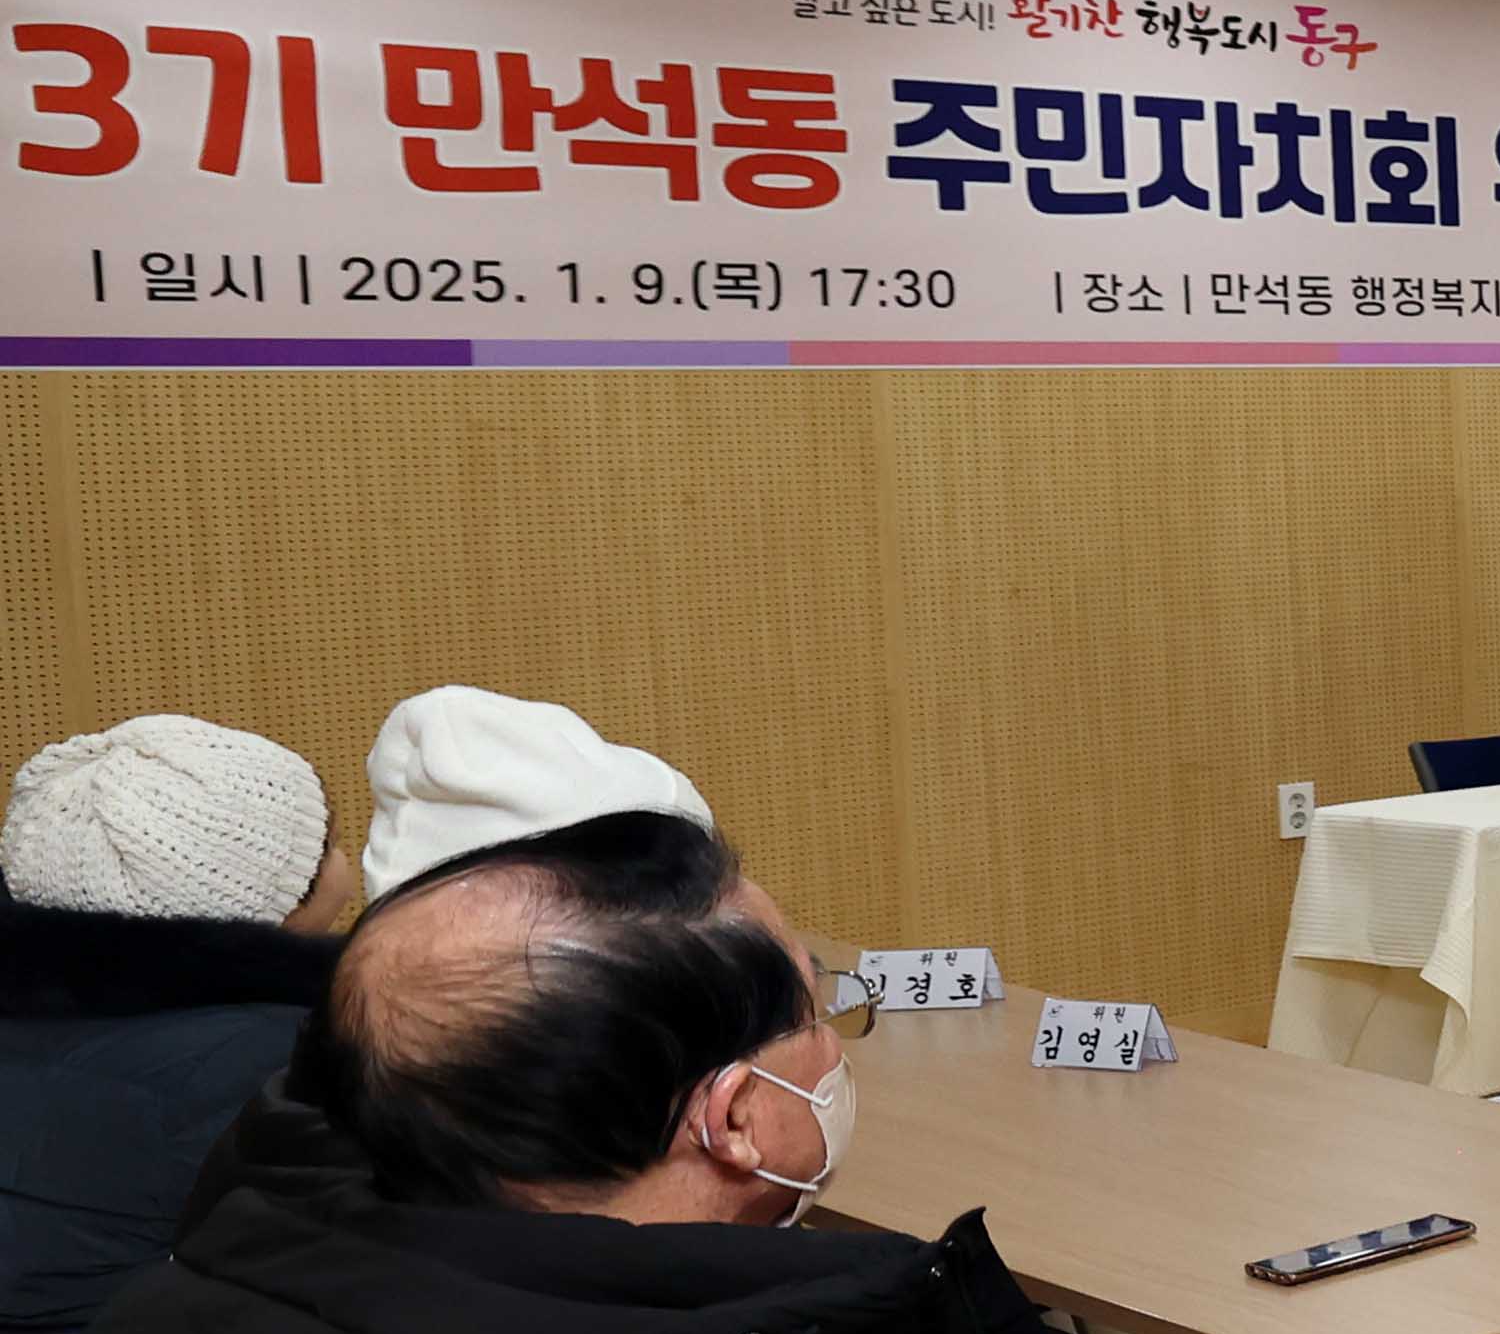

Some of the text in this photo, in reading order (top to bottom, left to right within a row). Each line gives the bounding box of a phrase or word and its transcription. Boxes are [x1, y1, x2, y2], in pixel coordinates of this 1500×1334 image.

[1286, 4, 1379, 70] 동구
[12, 22, 324, 185] 3기
[380, 43, 849, 211] 만석동
[887, 77, 1462, 228] 주민자치회
[139, 250, 266, 304] 일시
[340, 257, 527, 304] 2025.
[557, 261, 607, 305] 1.
[632, 259, 783, 312] 9.(목)
[809, 267, 956, 310] 17:30
[1083, 273, 1165, 316] 장소
[1210, 273, 1333, 317] 만석동
